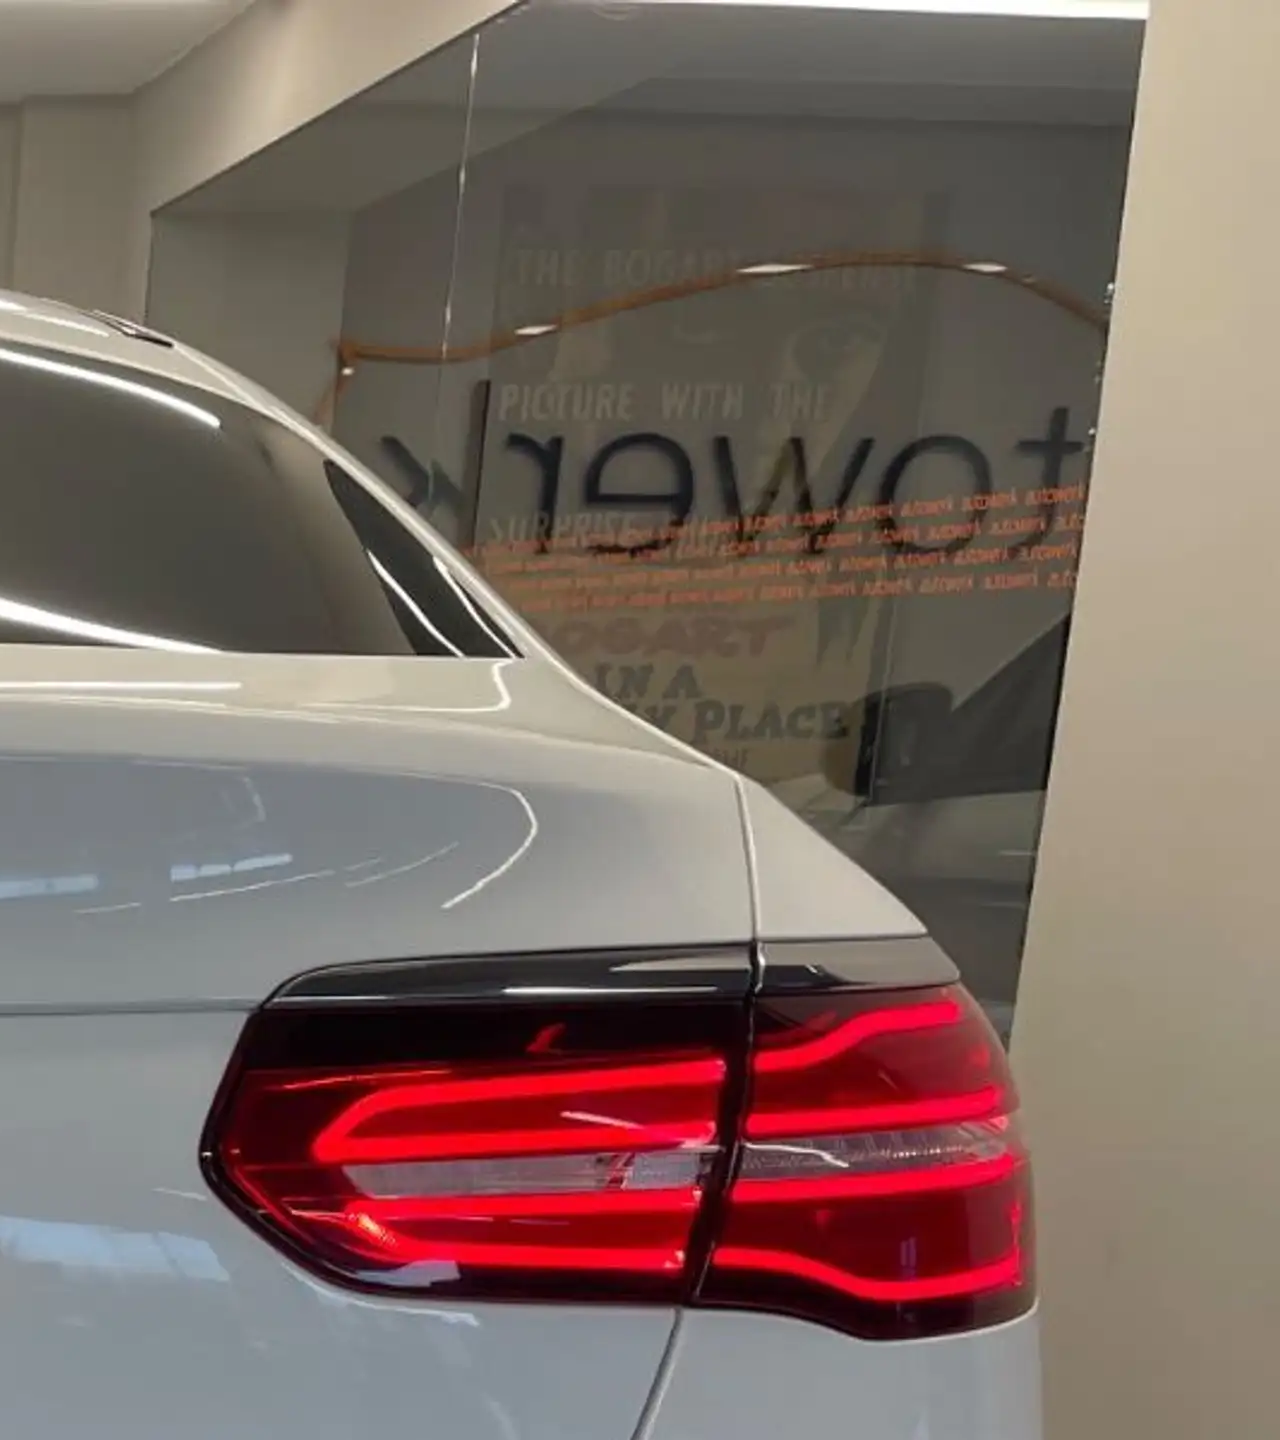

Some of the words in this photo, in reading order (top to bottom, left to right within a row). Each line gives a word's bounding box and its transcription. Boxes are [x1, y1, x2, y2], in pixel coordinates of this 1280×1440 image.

[517, 247, 583, 288] THE
[497, 381, 634, 422] PICTURE
[659, 380, 745, 422] WITH
[770, 381, 832, 422] THE
[692, 699, 851, 743] PLACE
